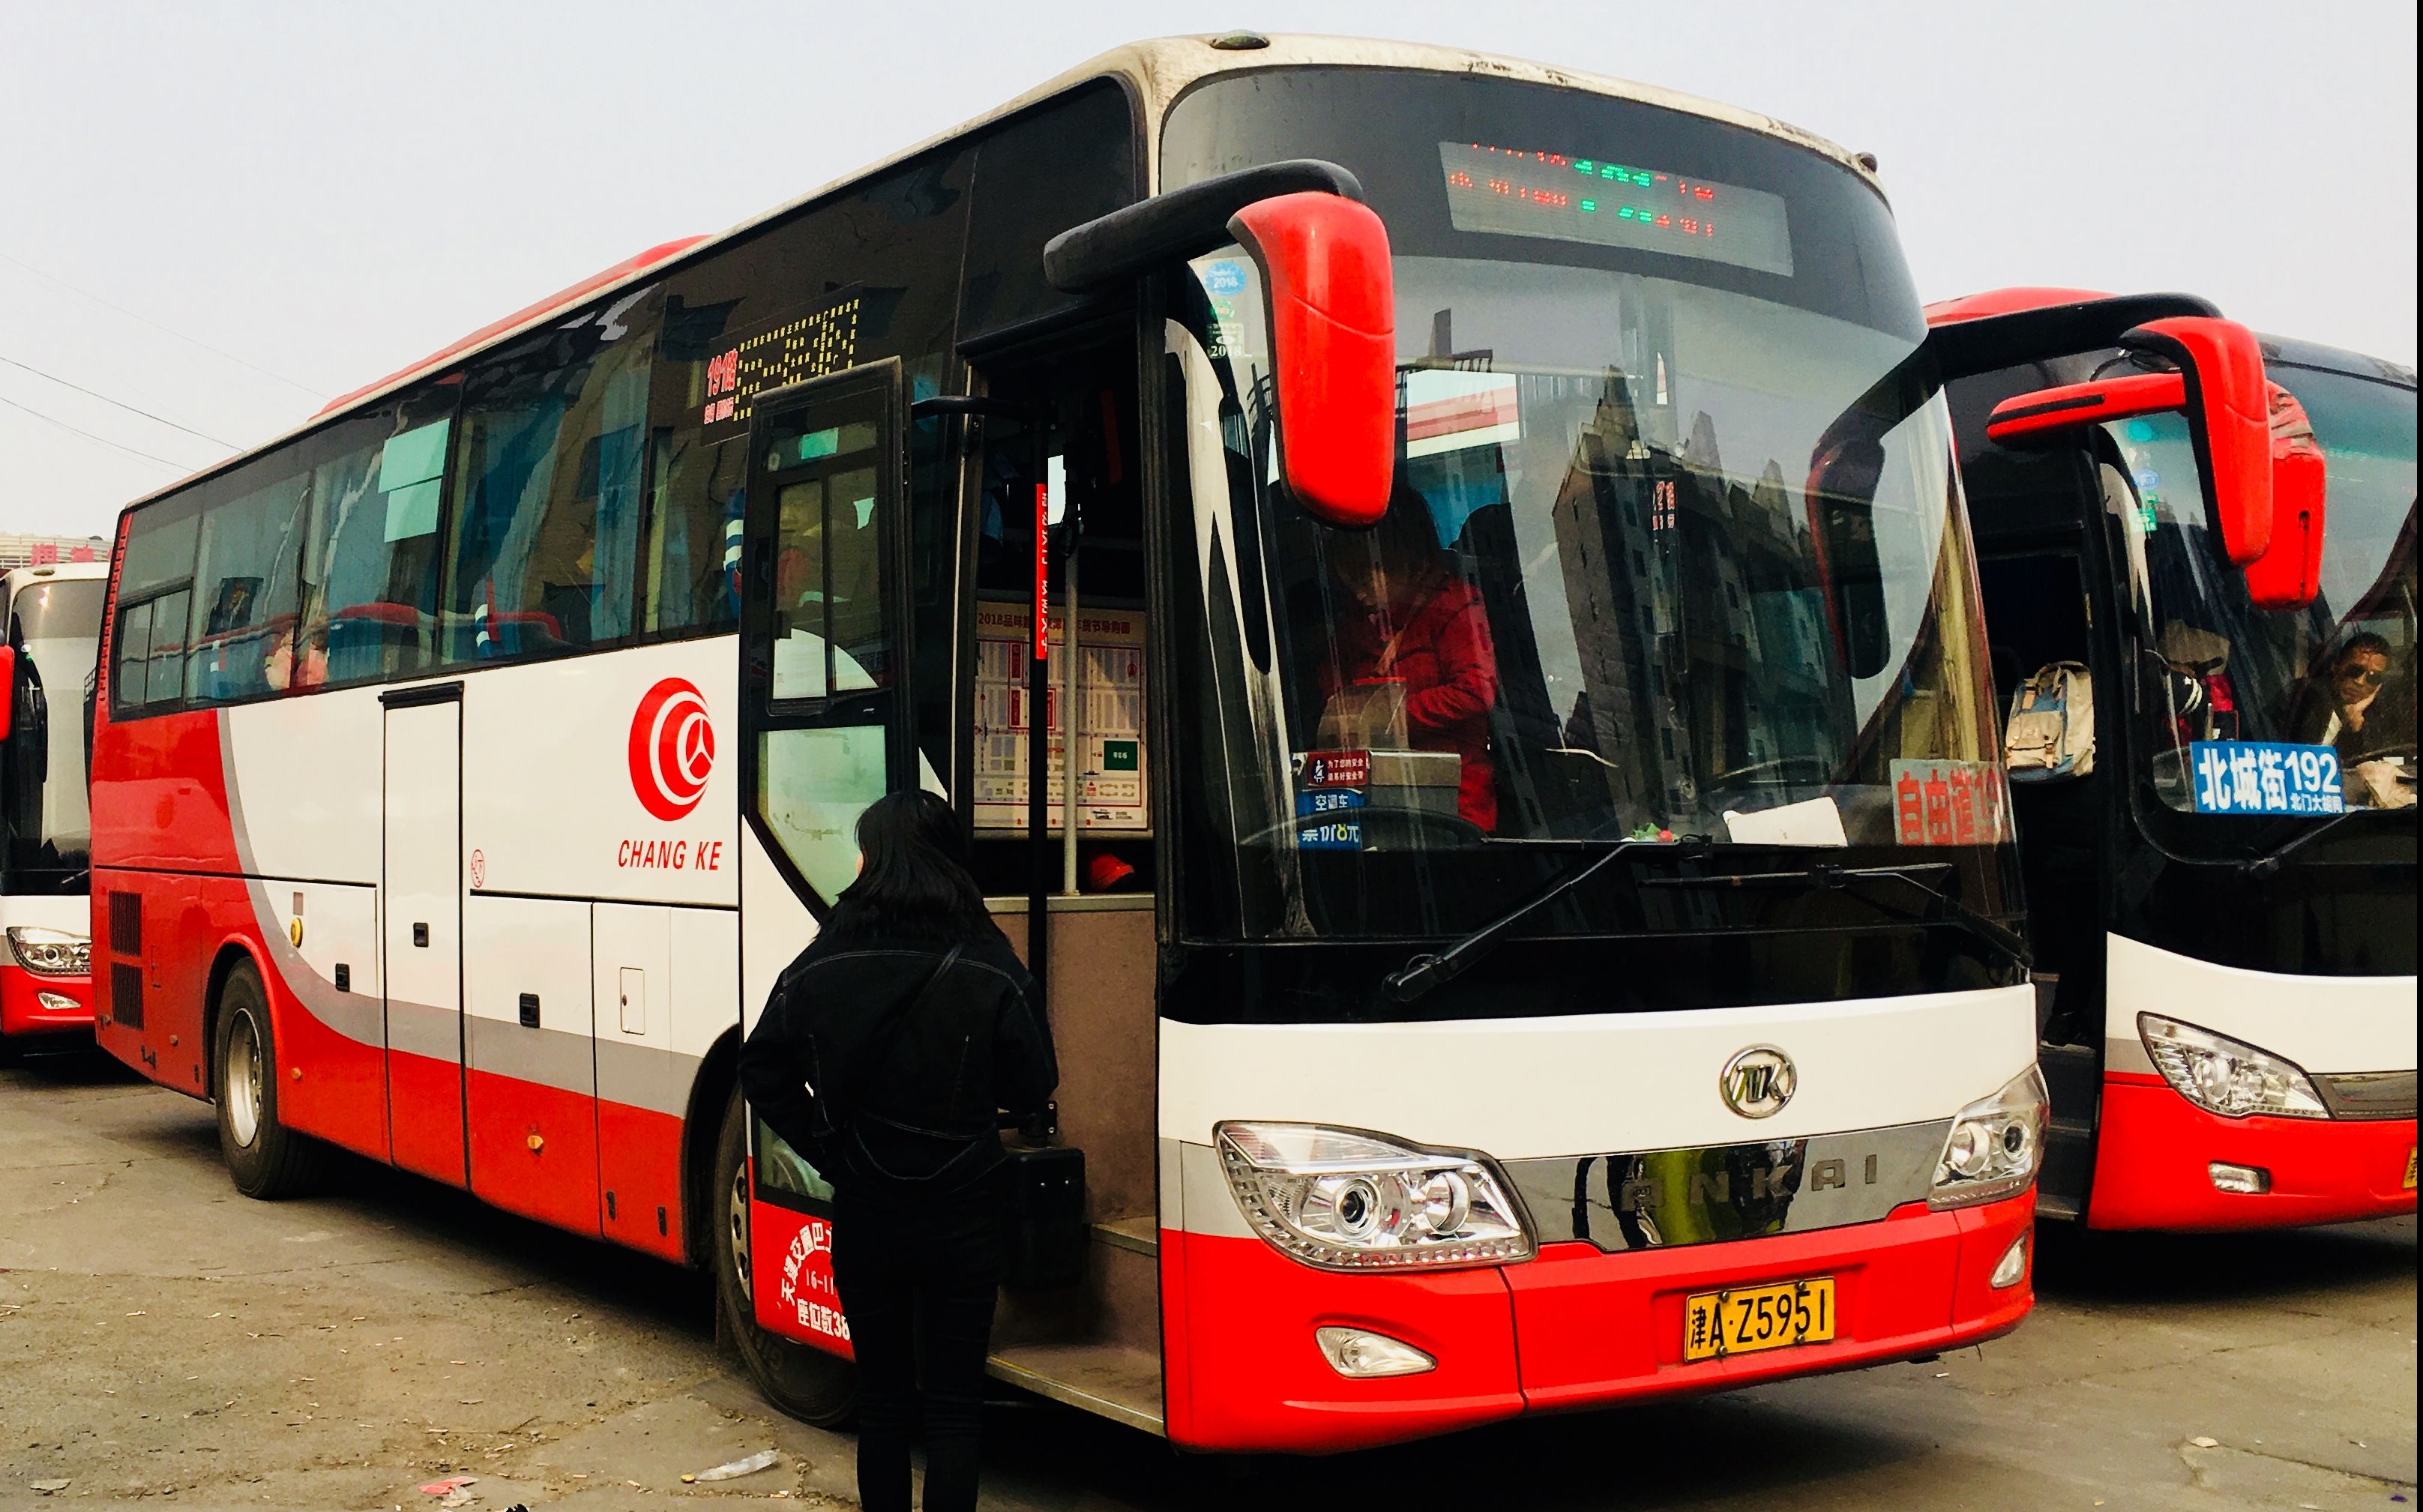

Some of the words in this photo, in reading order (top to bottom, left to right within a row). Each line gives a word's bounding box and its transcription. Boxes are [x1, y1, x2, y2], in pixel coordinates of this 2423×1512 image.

[1213, 277, 1238, 289] 2018
[1210, 345, 1242, 357] 2018
[2198, 747, 2341, 810] 北城街192
[1315, 794, 1349, 811] 空调车
[618, 840, 687, 869] CHANG
[695, 841, 723, 870] KE
[1621, 1154, 1877, 1212] ANKAI
